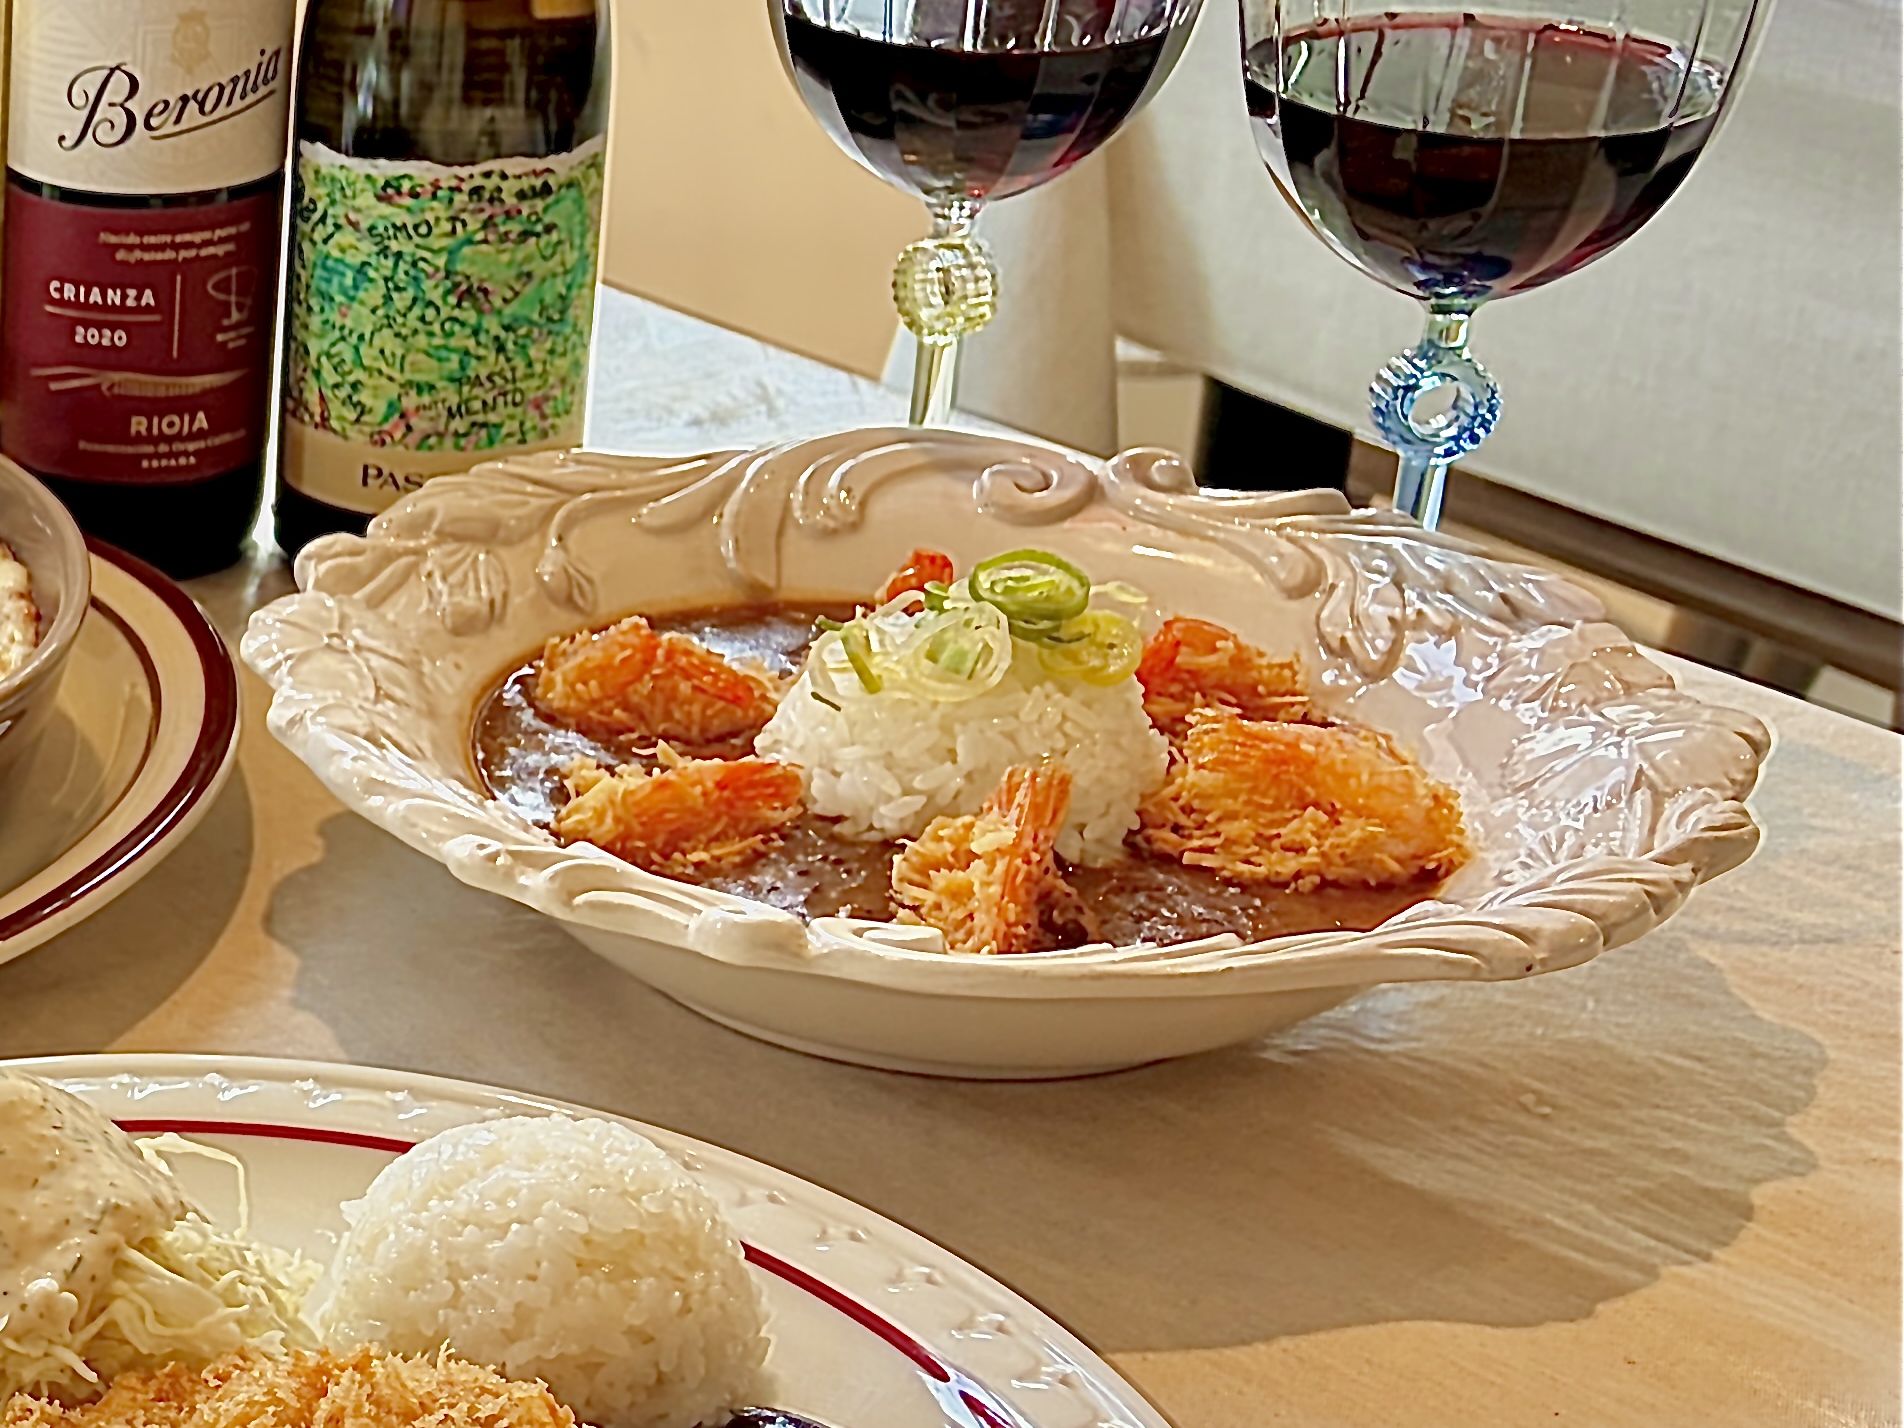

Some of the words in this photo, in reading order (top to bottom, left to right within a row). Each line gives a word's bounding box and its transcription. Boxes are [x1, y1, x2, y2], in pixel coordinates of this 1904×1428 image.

[58, 47, 282, 151] Beronia
[49, 279, 155, 308] CRIANZA
[74, 325, 127, 348] 2020
[130, 410, 209, 438] RIOJA
